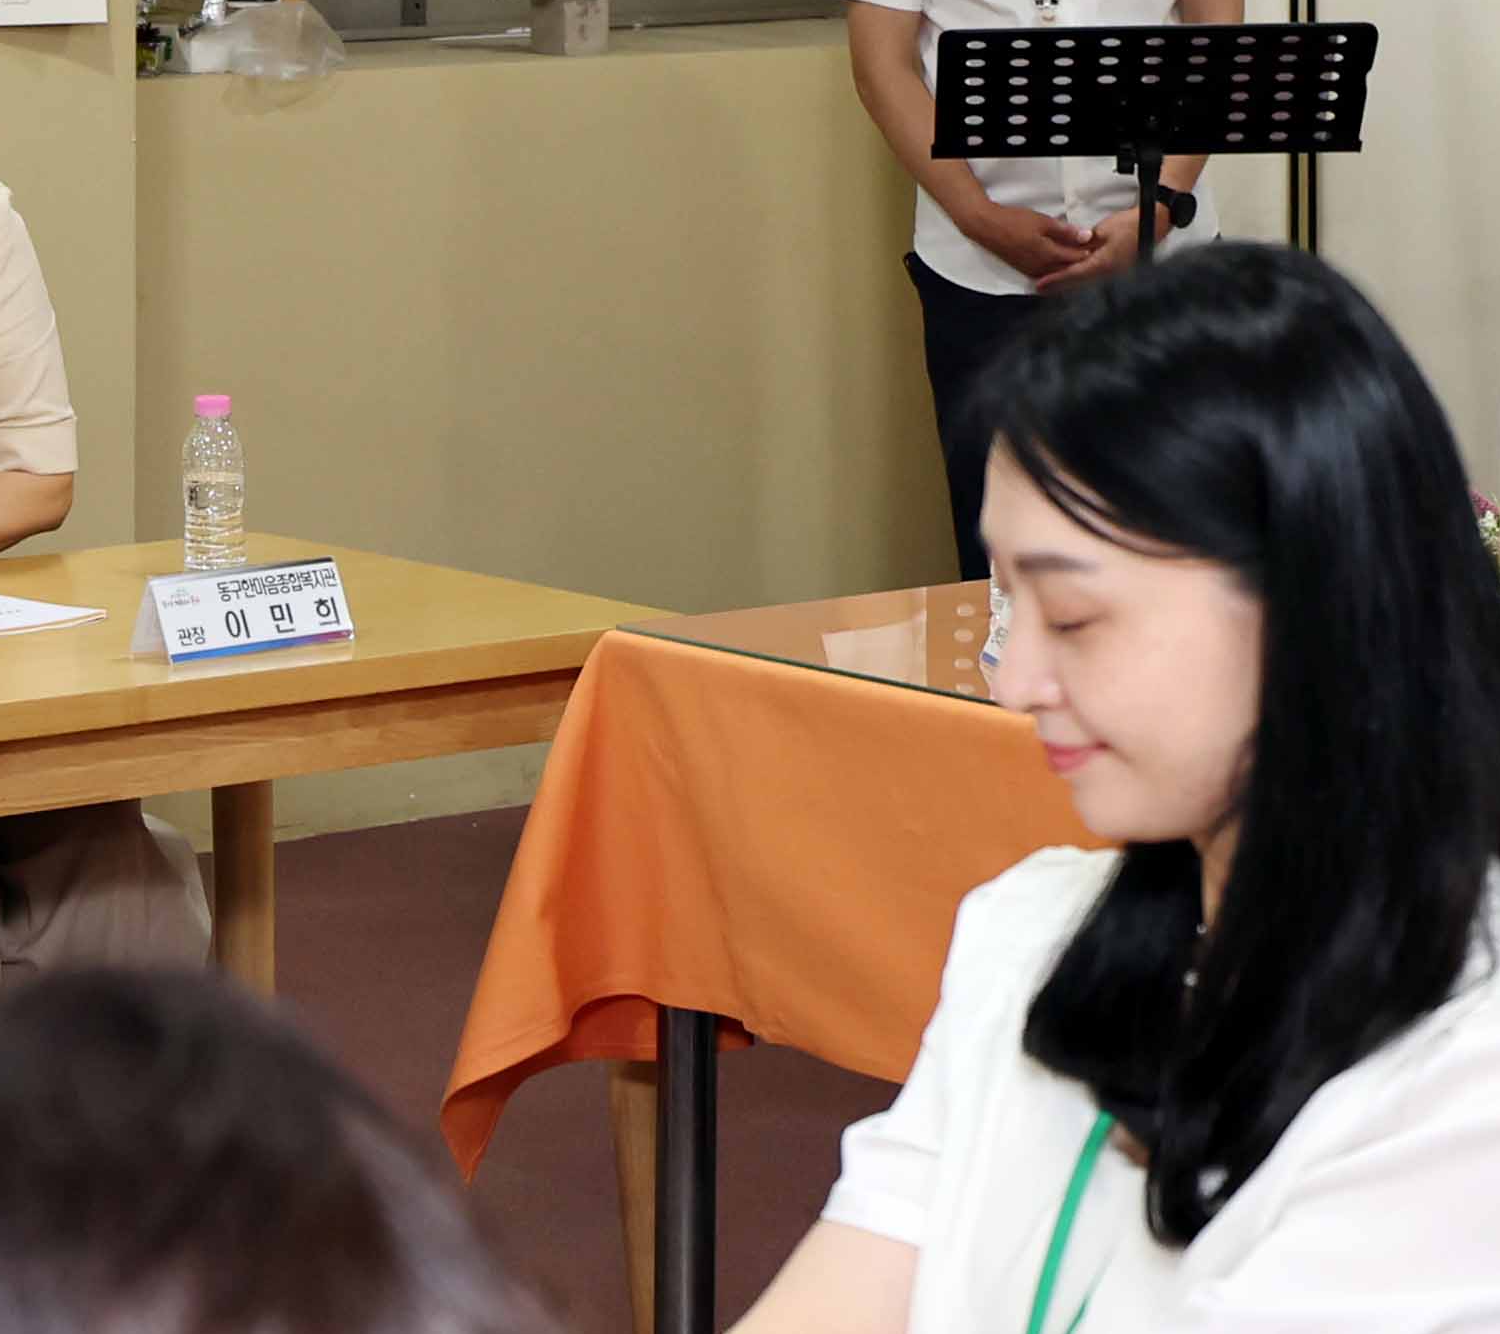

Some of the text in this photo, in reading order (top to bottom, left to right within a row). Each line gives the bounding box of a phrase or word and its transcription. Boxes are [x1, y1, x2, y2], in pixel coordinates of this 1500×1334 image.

[216, 568, 337, 603] 동구한마음종합복지관
[177, 596, 341, 647] 관장 이 민 희
